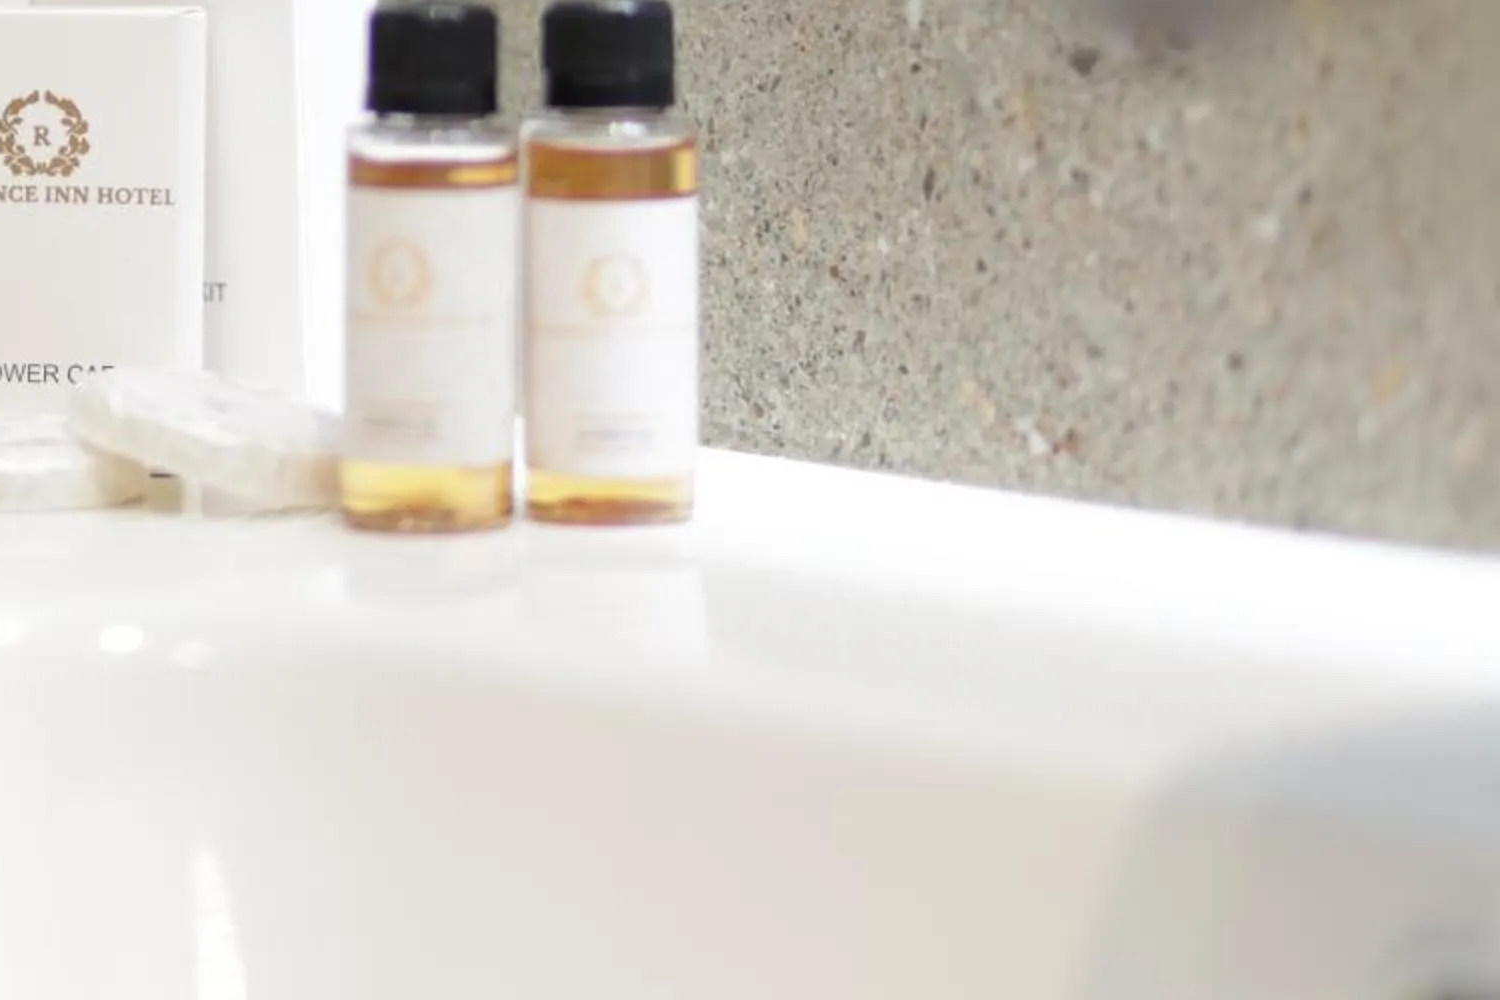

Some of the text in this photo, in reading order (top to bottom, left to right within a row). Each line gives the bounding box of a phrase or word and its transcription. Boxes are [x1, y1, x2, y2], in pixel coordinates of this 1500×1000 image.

[33, 125, 51, 147] R
[45, 185, 90, 204] INN
[98, 187, 176, 206] HOTEL
